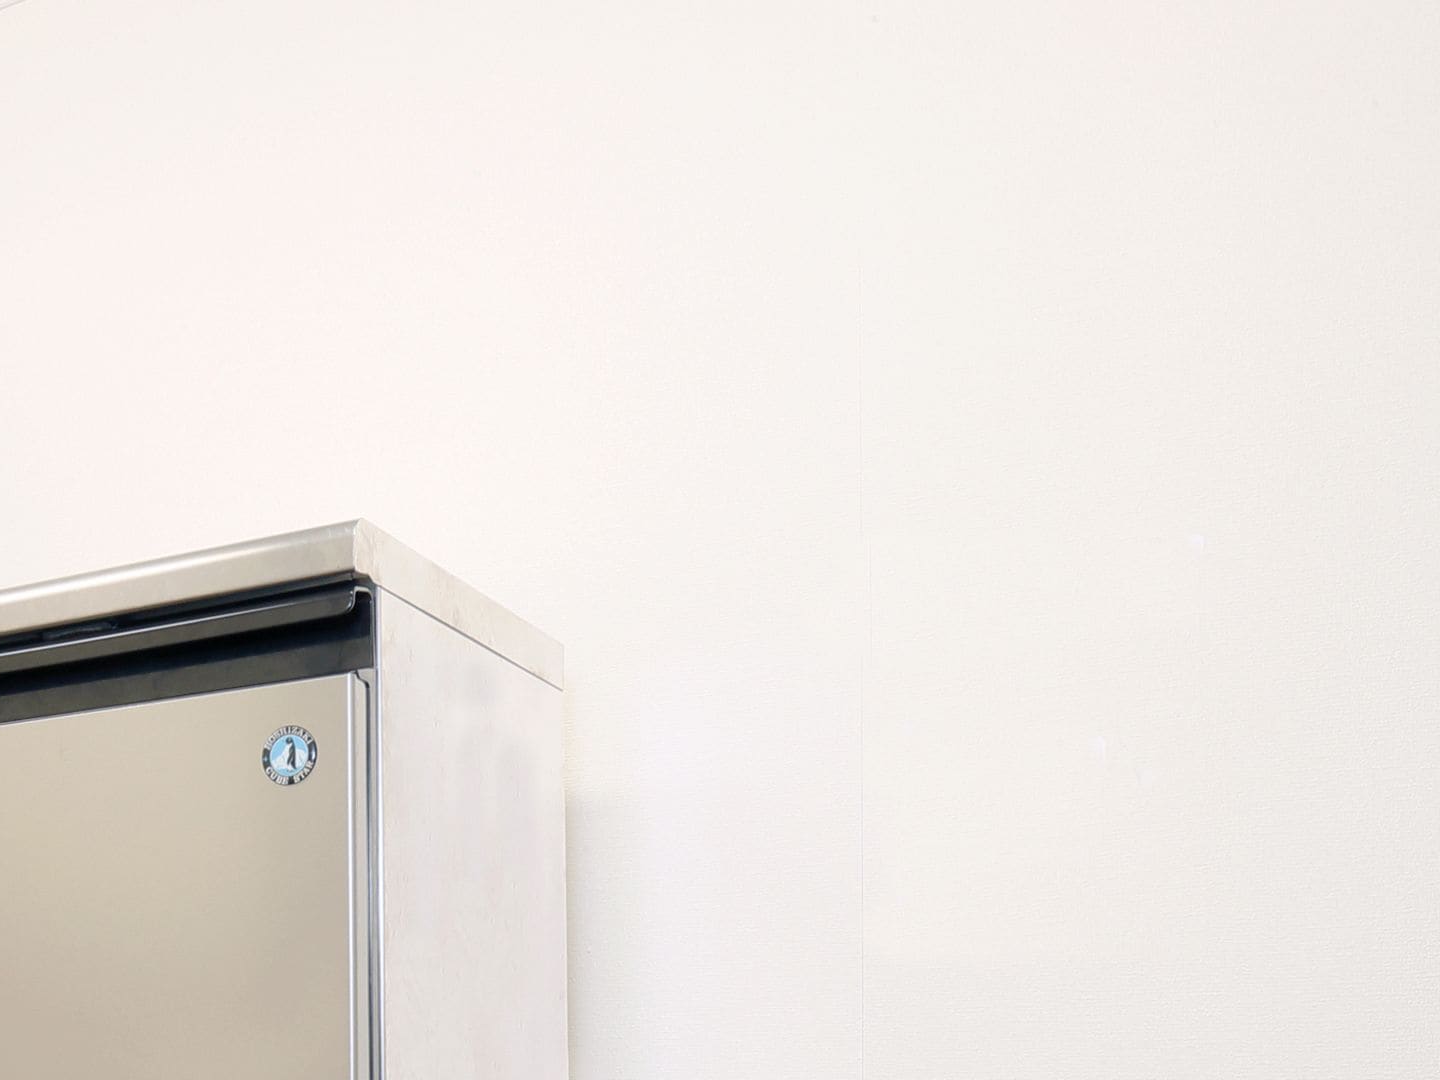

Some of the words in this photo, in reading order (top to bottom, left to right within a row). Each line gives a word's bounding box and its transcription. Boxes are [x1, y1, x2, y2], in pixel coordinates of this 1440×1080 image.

[263, 726, 314, 750] HOSHIZAKI
[266, 766, 289, 785] CUBE
[293, 760, 314, 784] STAR
